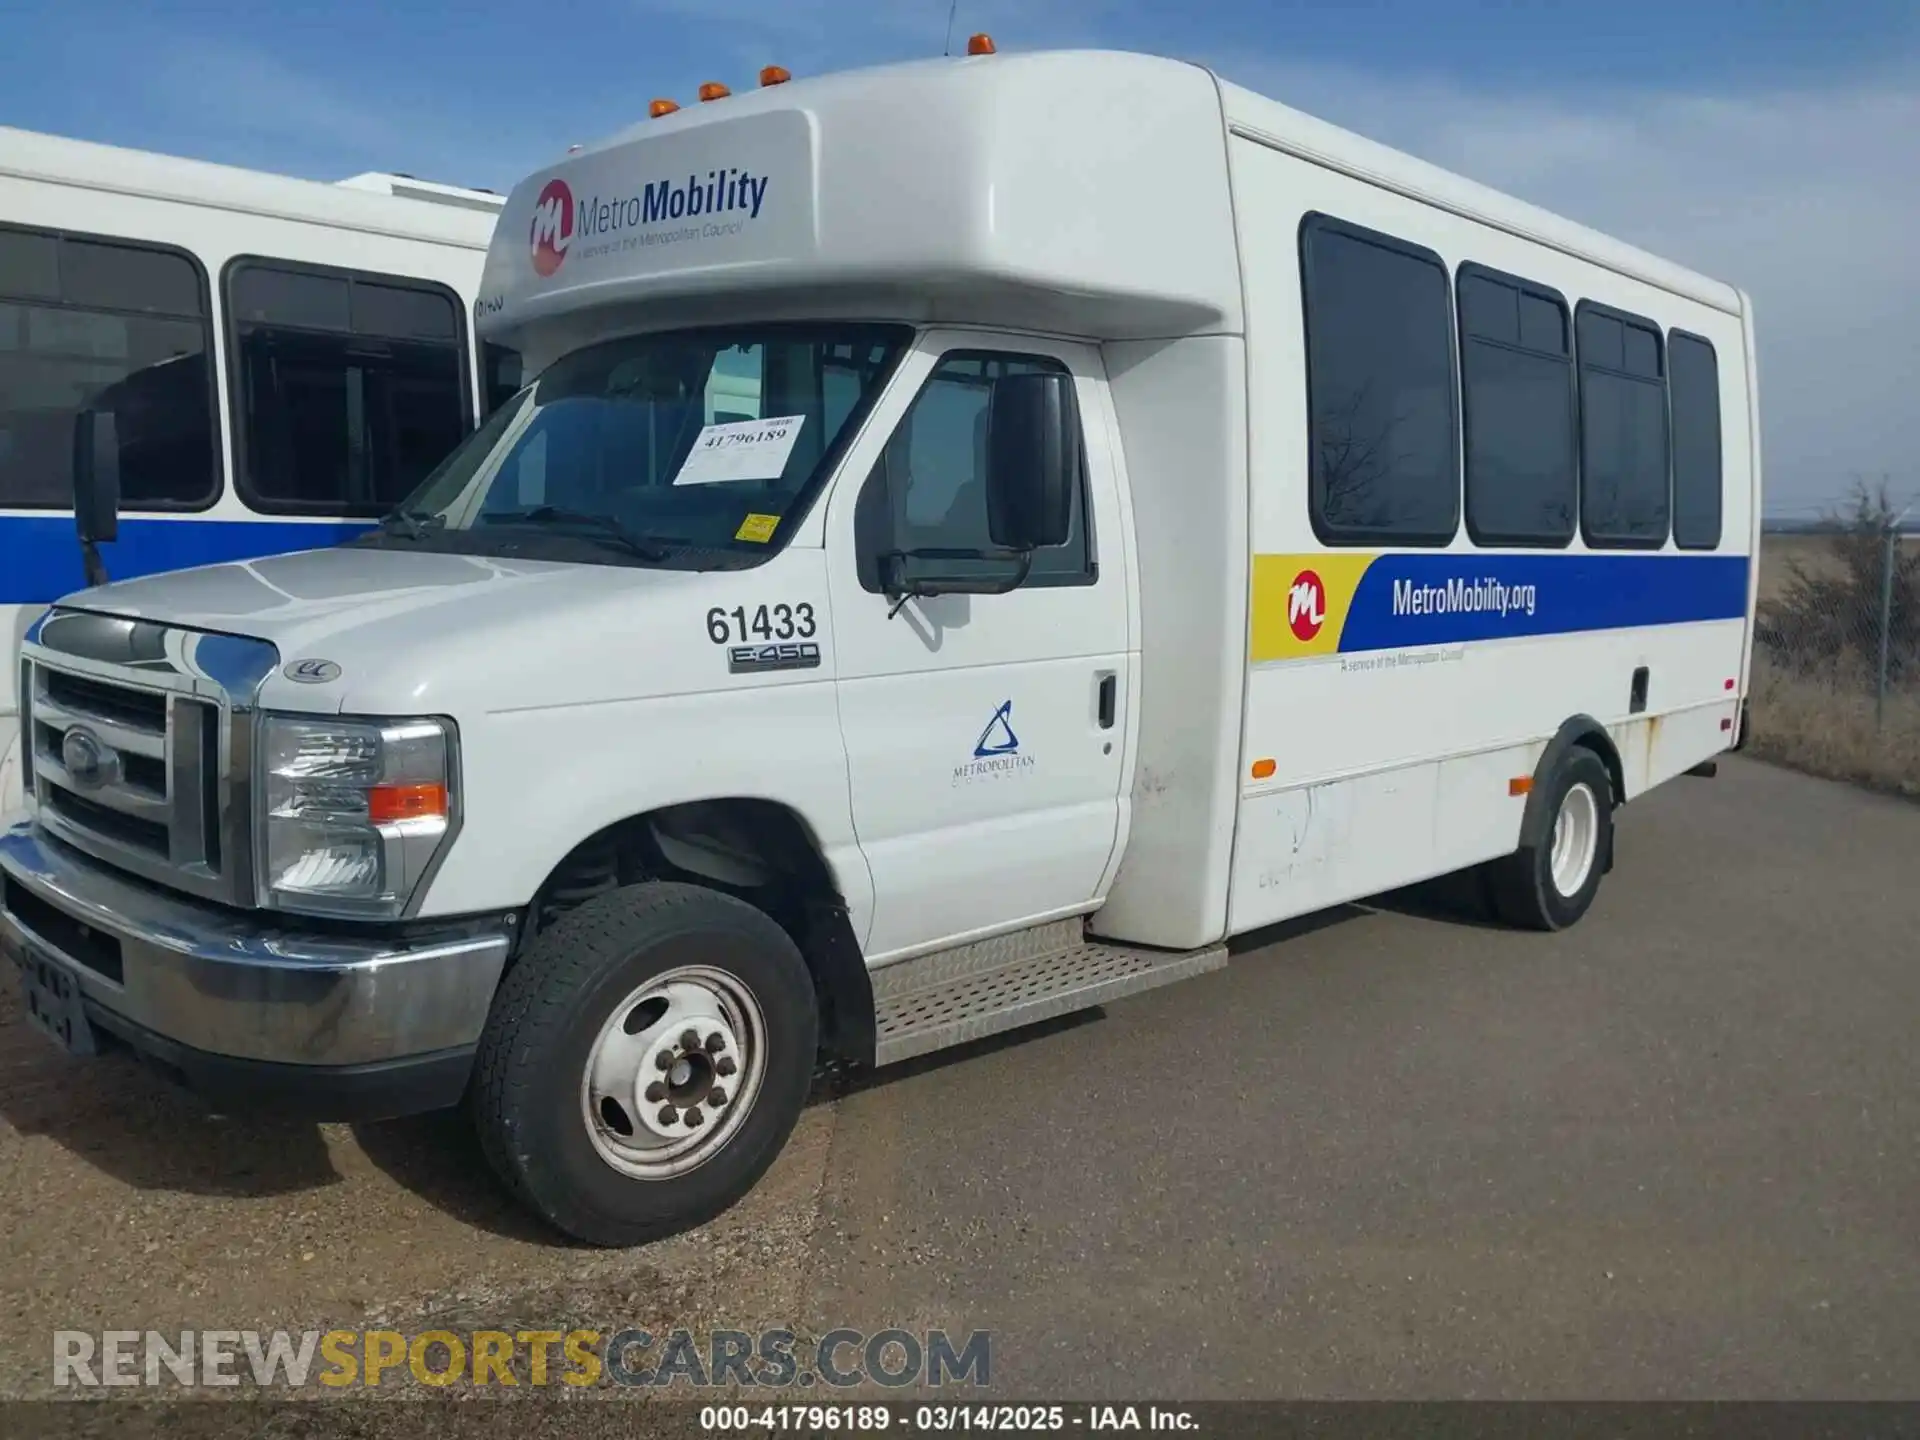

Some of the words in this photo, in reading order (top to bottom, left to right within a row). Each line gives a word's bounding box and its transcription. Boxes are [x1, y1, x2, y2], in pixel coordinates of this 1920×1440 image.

[576, 168, 769, 240] MetroMobility
[702, 219, 744, 239] Council
[705, 429, 787, 447] 41796189
[1393, 577, 1536, 617] MetroMobility.org
[706, 602, 817, 645] 61433
[953, 755, 1035, 778] METROPOLITAN
